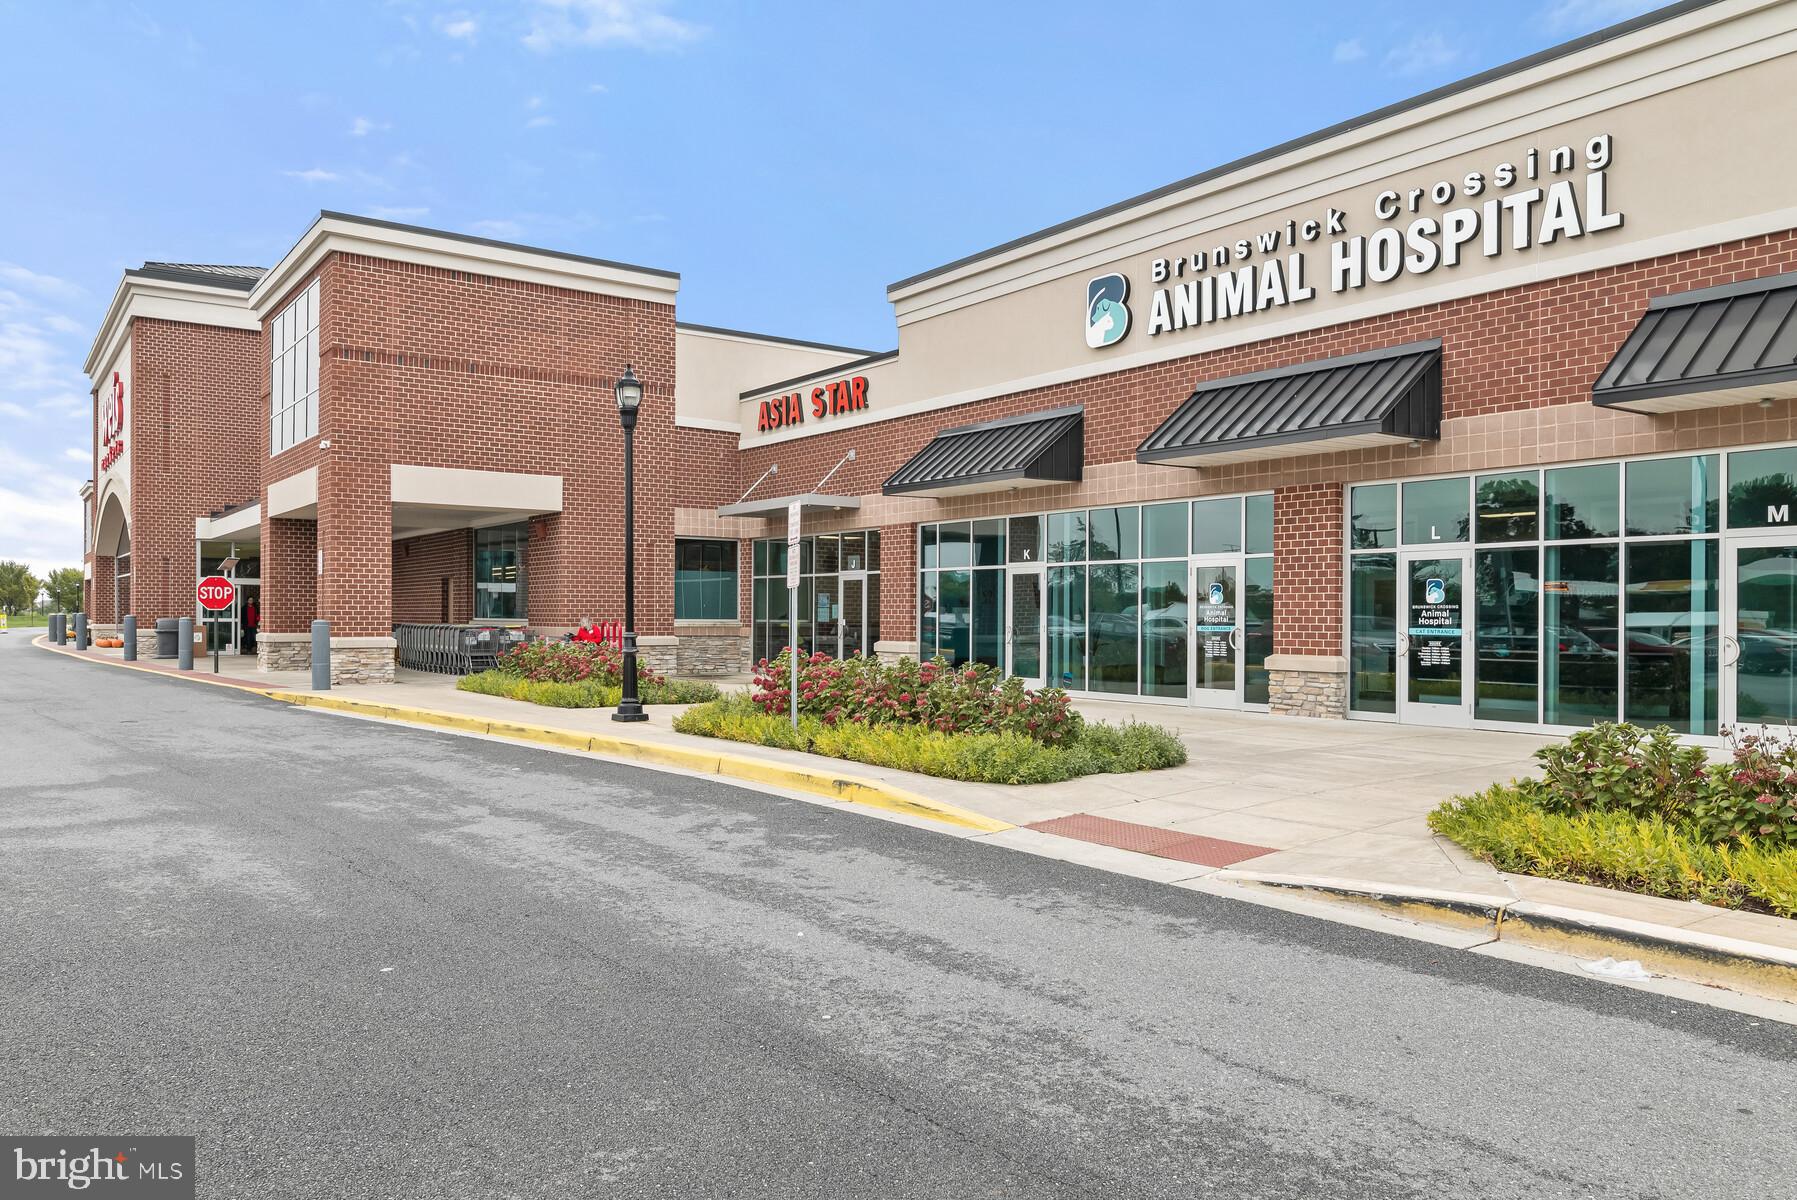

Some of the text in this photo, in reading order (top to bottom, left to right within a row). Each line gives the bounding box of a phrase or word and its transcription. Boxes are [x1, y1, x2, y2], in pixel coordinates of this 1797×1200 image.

[1151, 133, 1613, 283] Brunswick Crossing
[1147, 171, 1625, 336] ANIMAL HOSPITAL
[758, 376, 869, 431] ASIA STAR
[1767, 504, 1789, 523] M
[1431, 525, 1441, 540] L
[1023, 549, 1031, 560] K
[199, 586, 233, 600] STOP
[1203, 616, 1229, 624] Hospital
[1206, 609, 1228, 617] Animal
[1421, 609, 1450, 618] Animal
[1418, 617, 1452, 626] Hospital
